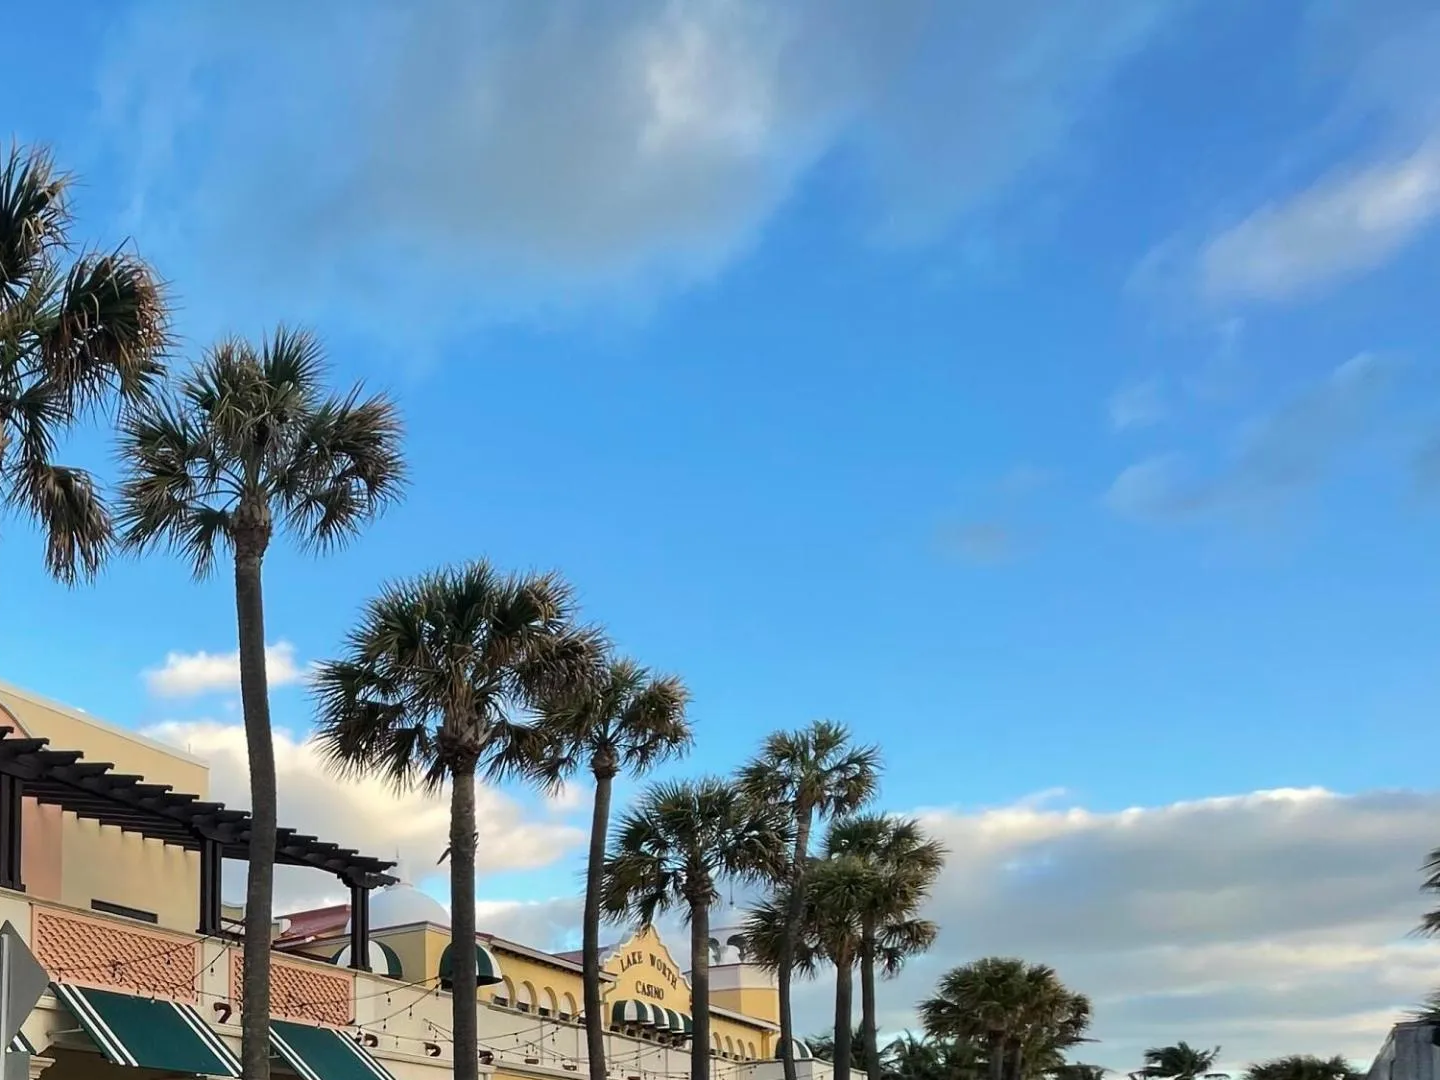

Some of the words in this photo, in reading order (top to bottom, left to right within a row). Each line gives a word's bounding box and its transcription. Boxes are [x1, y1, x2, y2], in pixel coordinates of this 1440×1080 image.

[620, 951, 643, 972] LAKE
[649, 953, 678, 990] WORTH
[635, 980, 665, 1000] CASINO
